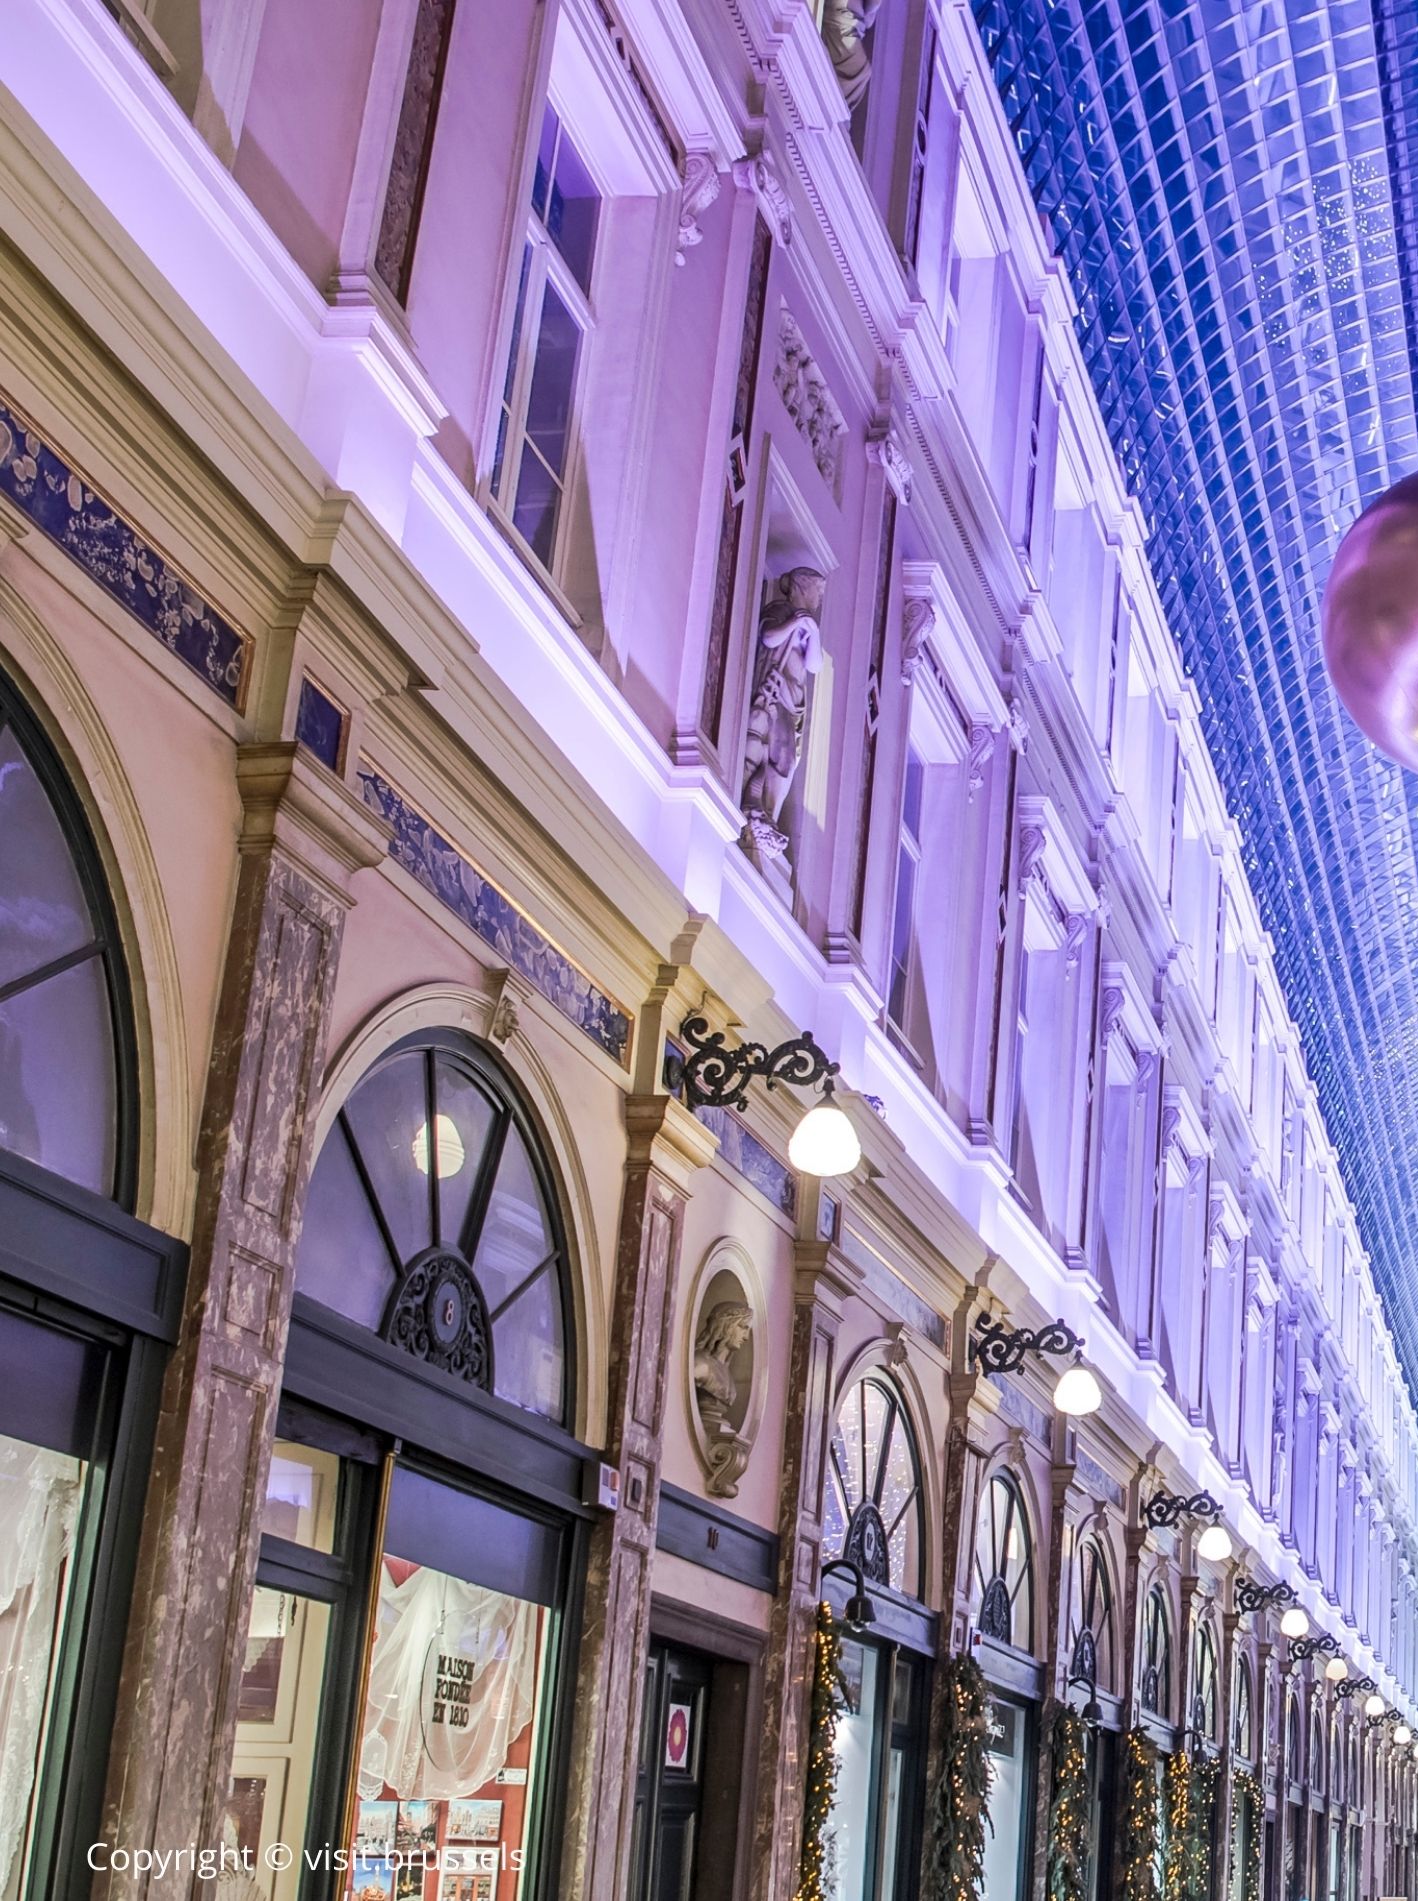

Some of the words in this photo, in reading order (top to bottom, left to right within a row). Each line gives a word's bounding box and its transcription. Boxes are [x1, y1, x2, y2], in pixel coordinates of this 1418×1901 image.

[444, 1299, 455, 1326] 8
[437, 1654, 475, 1681] MAISON
[432, 1702, 446, 1724] EN
[449, 1705, 469, 1728] 1810
